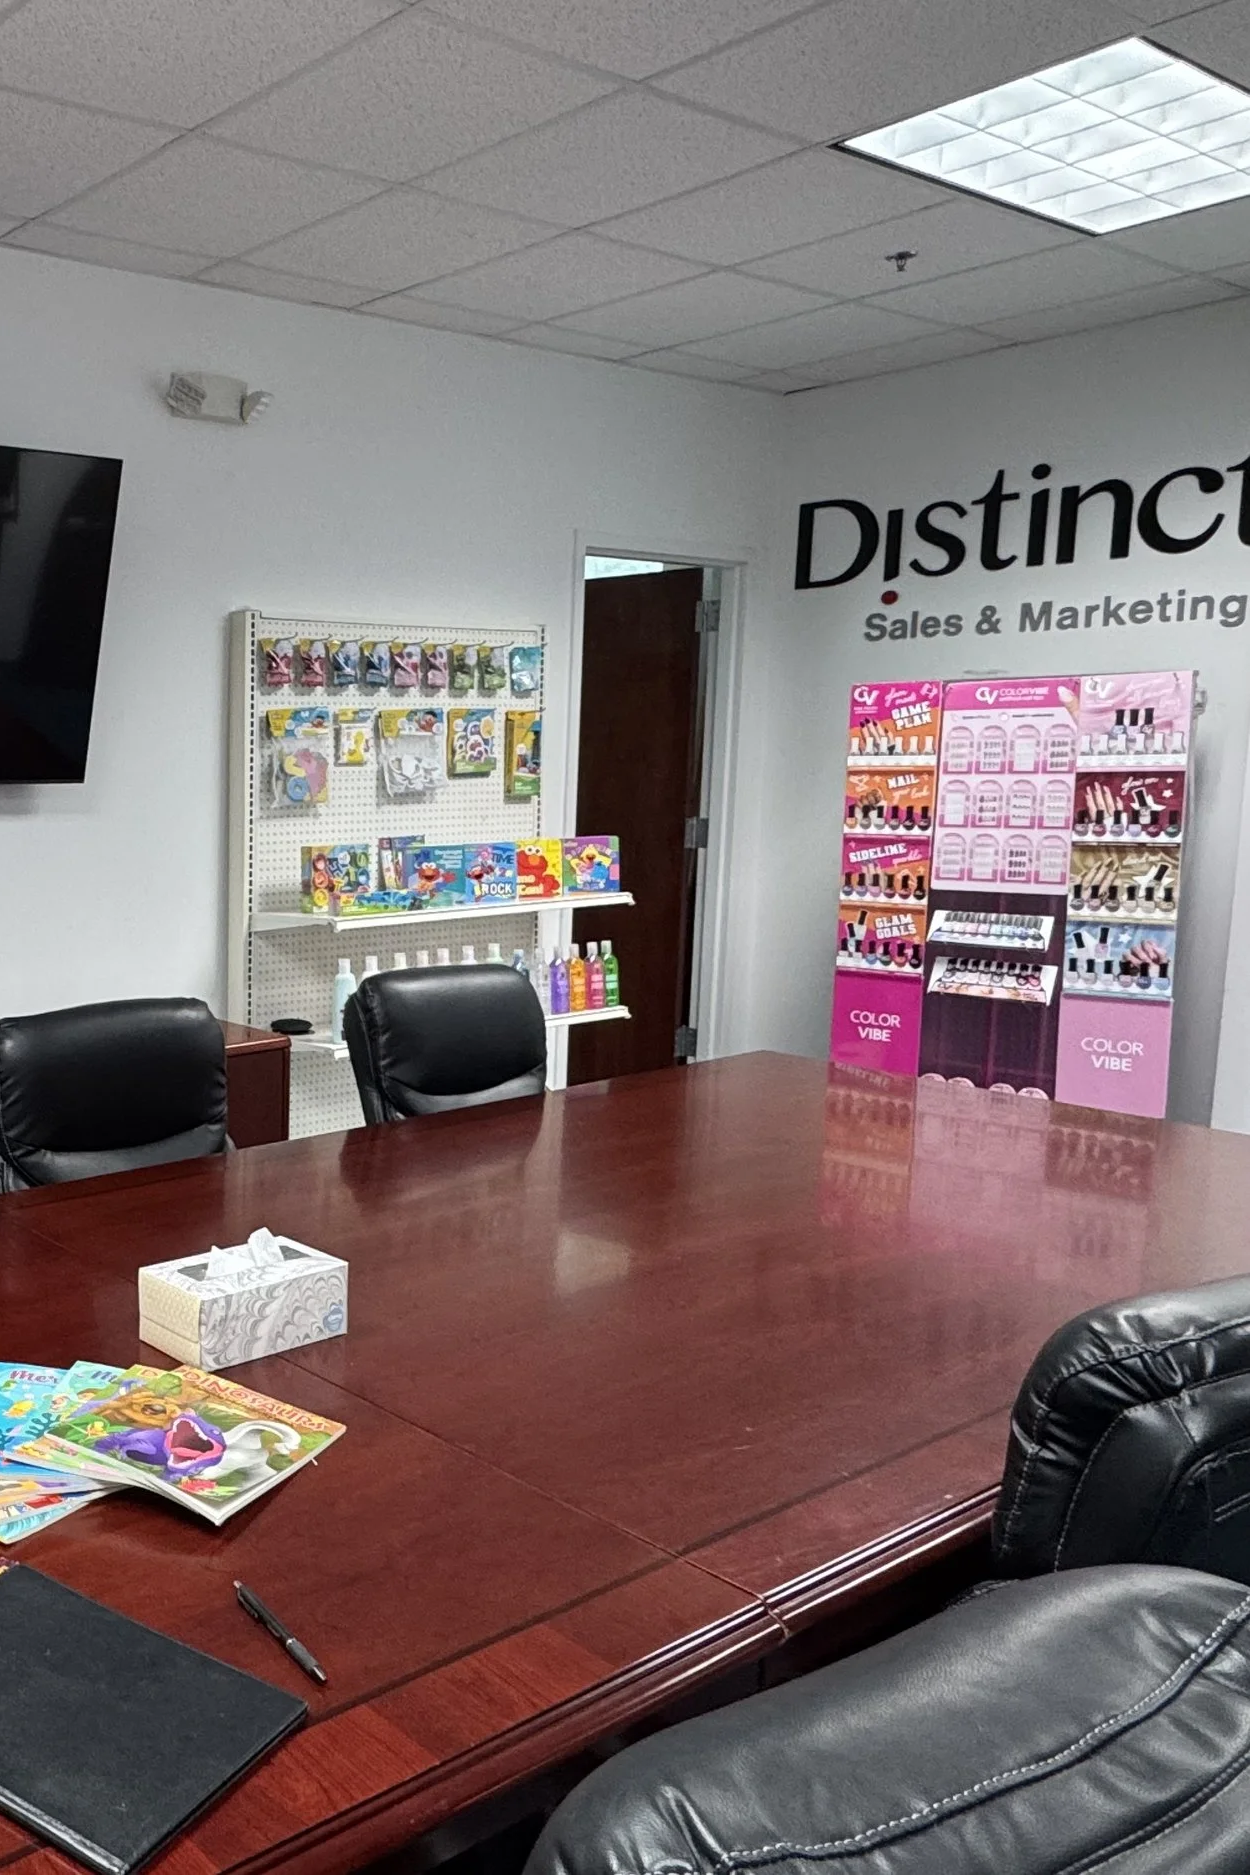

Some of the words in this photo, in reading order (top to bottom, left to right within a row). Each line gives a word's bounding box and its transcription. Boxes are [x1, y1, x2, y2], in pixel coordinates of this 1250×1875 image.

[863, 611, 963, 641] Sales
[975, 605, 1001, 635] &
[1019, 589, 1249, 633] Marketing
[481, 882, 513, 897] ROCK
[875, 914, 914, 929] GLAM
[876, 924, 917, 940] GOALS
[850, 1010, 901, 1028] COLOR
[858, 1026, 892, 1042] VIBE
[1081, 1037, 1144, 1056] COLOR
[1091, 1054, 1132, 1072] VIBE
[183, 1371, 329, 1431] DINOSAURS
